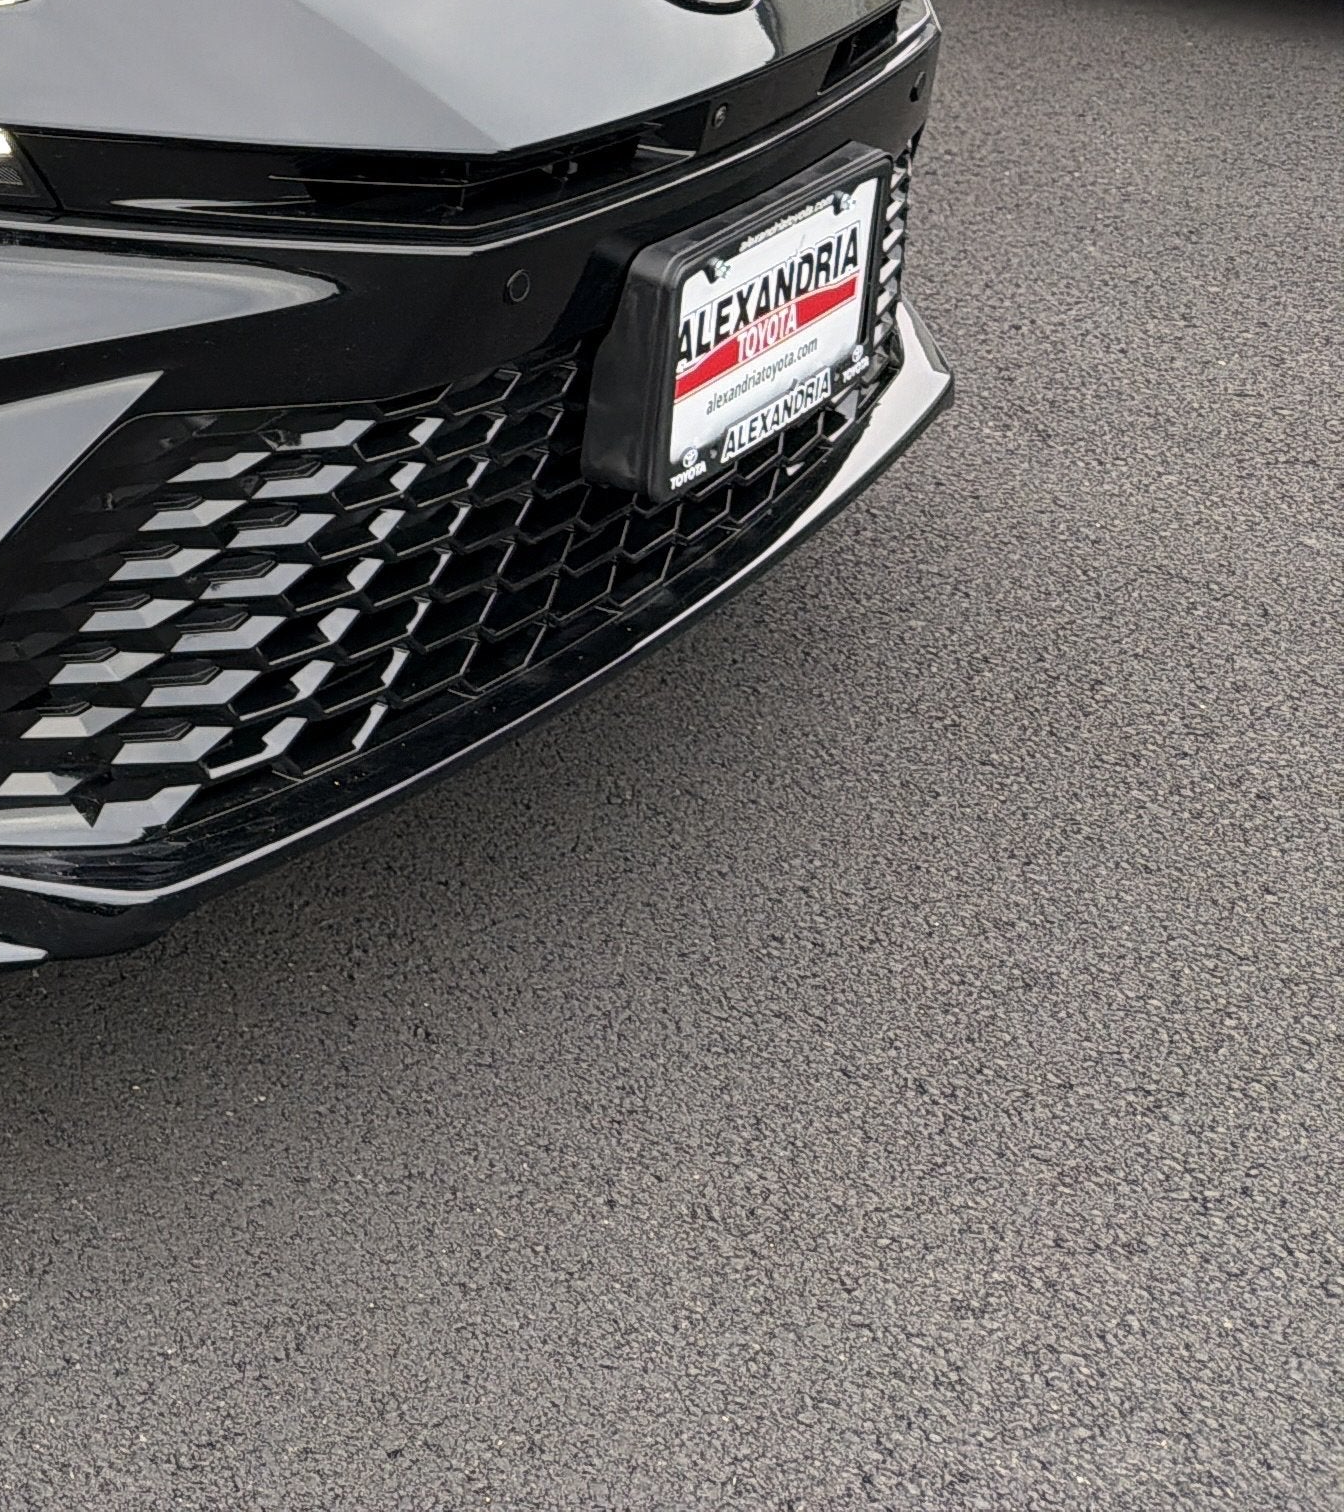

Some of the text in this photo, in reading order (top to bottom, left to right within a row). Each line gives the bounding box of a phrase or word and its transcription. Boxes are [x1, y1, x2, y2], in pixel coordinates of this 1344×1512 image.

[678, 227, 859, 362] ALEXANDRIA
[737, 303, 798, 362] TOYOTA
[706, 338, 818, 415] alexandriatoyota.com
[724, 372, 830, 458] ALEXANDRIA
[670, 460, 707, 490] TOYOTA
